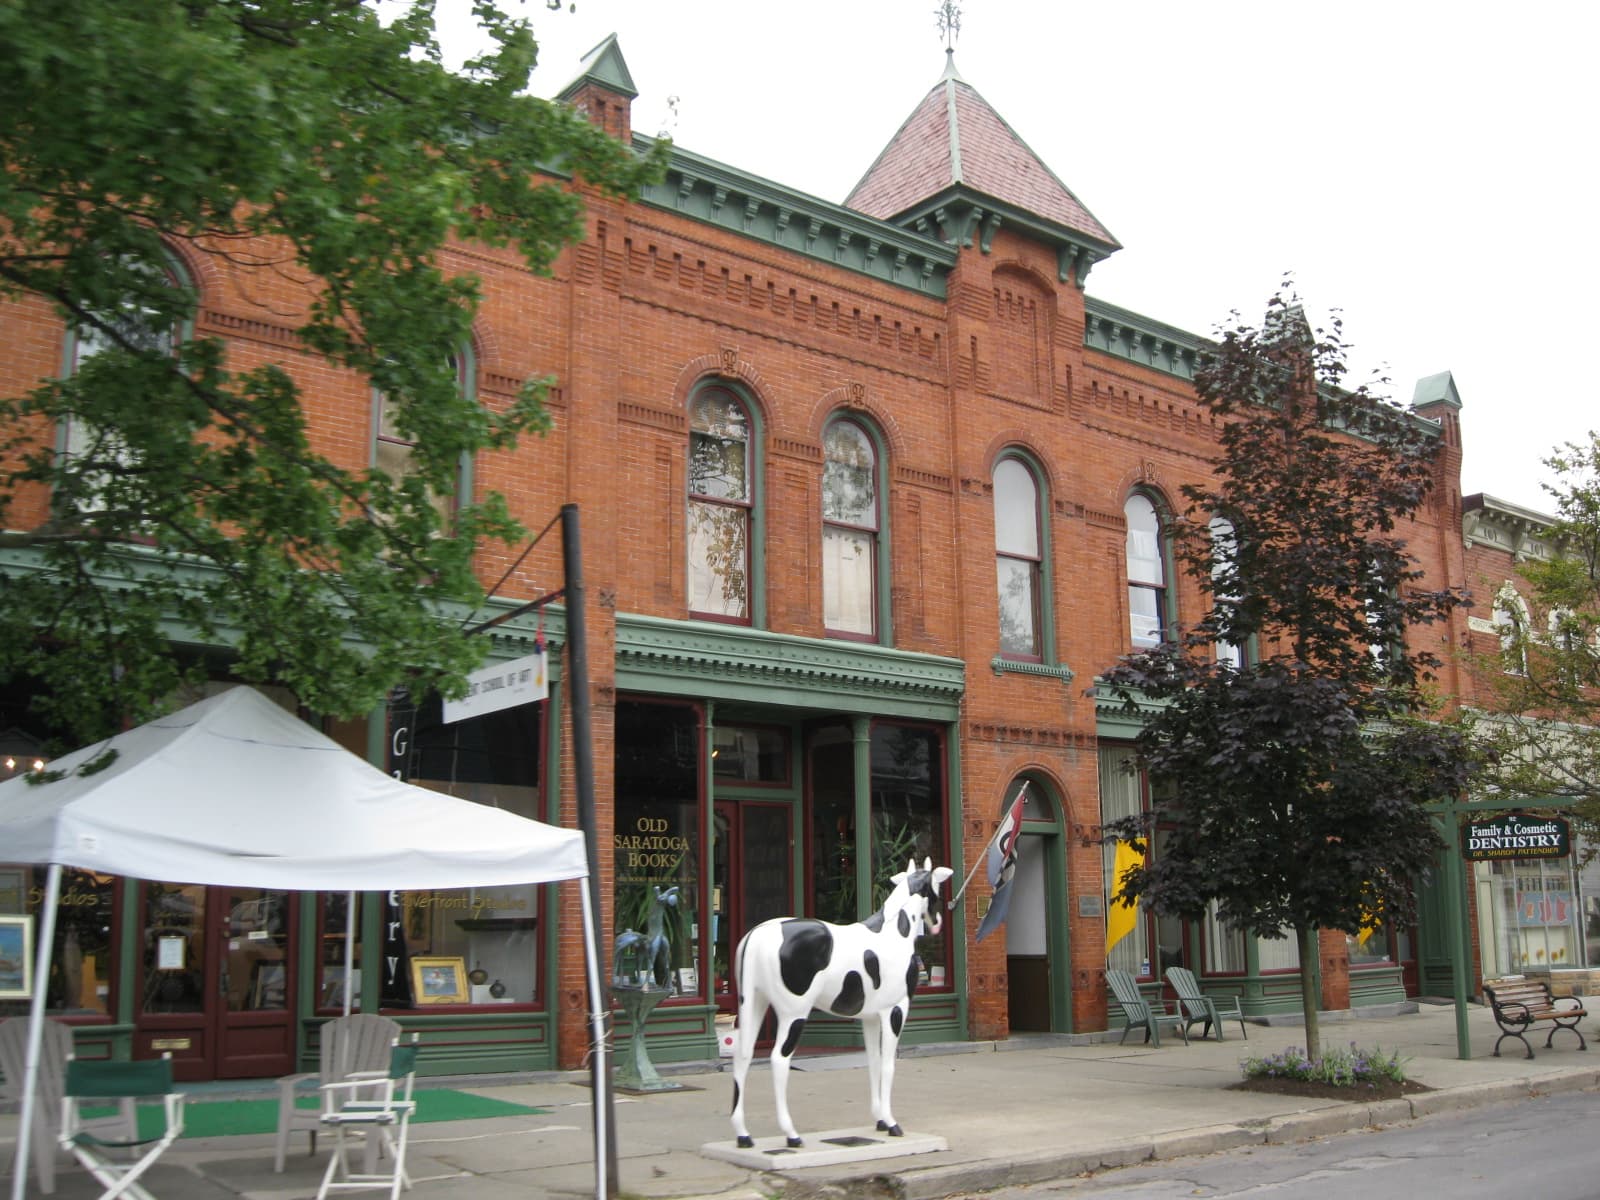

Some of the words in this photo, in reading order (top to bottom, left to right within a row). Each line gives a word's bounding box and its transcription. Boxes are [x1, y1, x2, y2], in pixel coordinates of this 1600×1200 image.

[637, 817, 668, 832] OLD
[1471, 824, 1502, 839] Family
[1504, 825, 1512, 835] &
[1514, 821, 1557, 835] Cosmetic
[614, 834, 689, 850] SARATOGA
[1468, 834, 1561, 850] DENTISTRY
[628, 852, 677, 868] BOOKS
